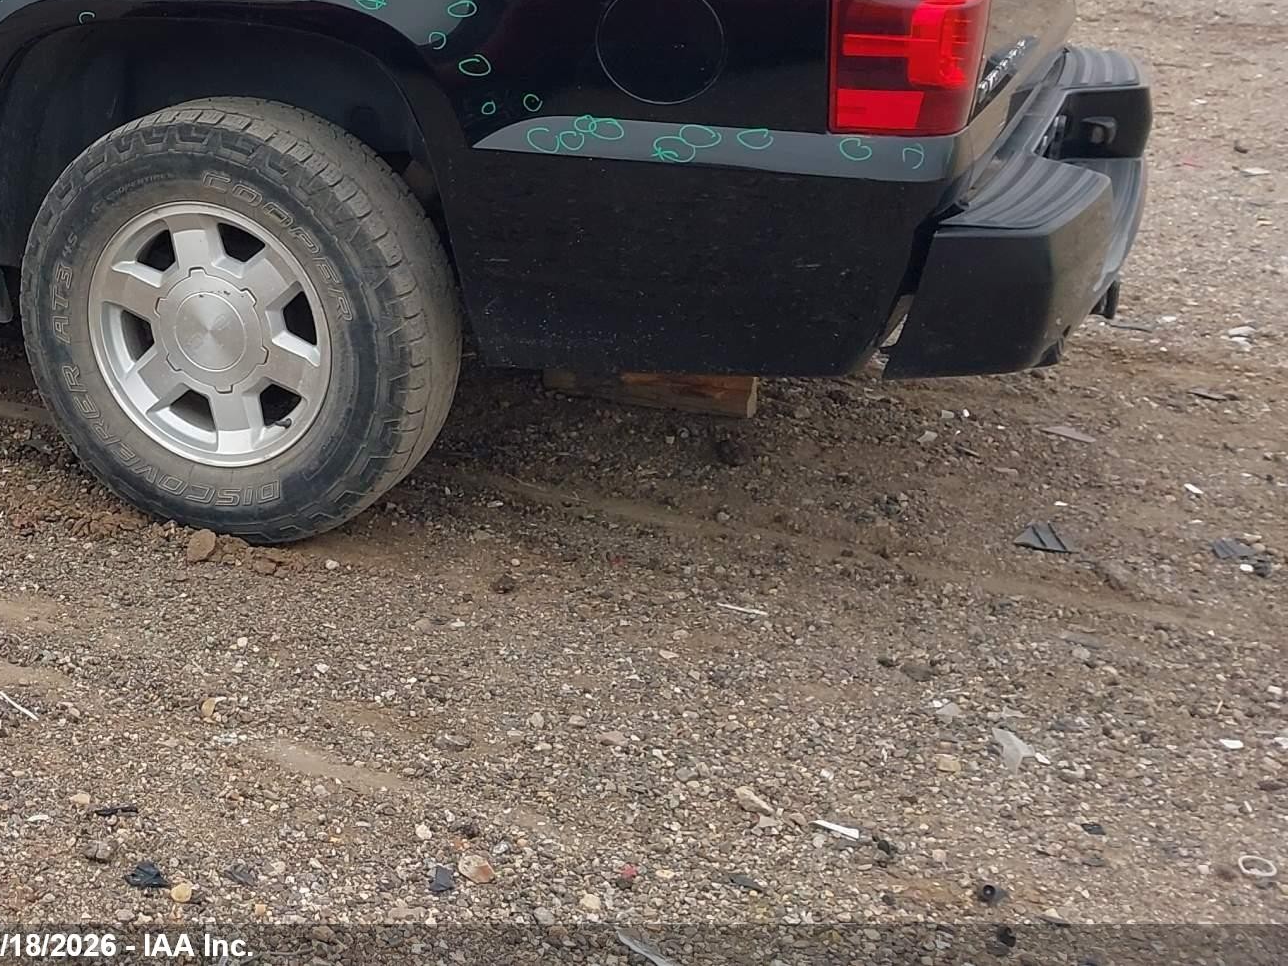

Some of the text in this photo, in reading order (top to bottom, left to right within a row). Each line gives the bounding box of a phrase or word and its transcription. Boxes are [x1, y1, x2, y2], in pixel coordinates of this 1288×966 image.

[52, 260, 74, 345] AT3
[202, 170, 353, 322] COOPER
[61, 364, 281, 506] DISCOVERER
